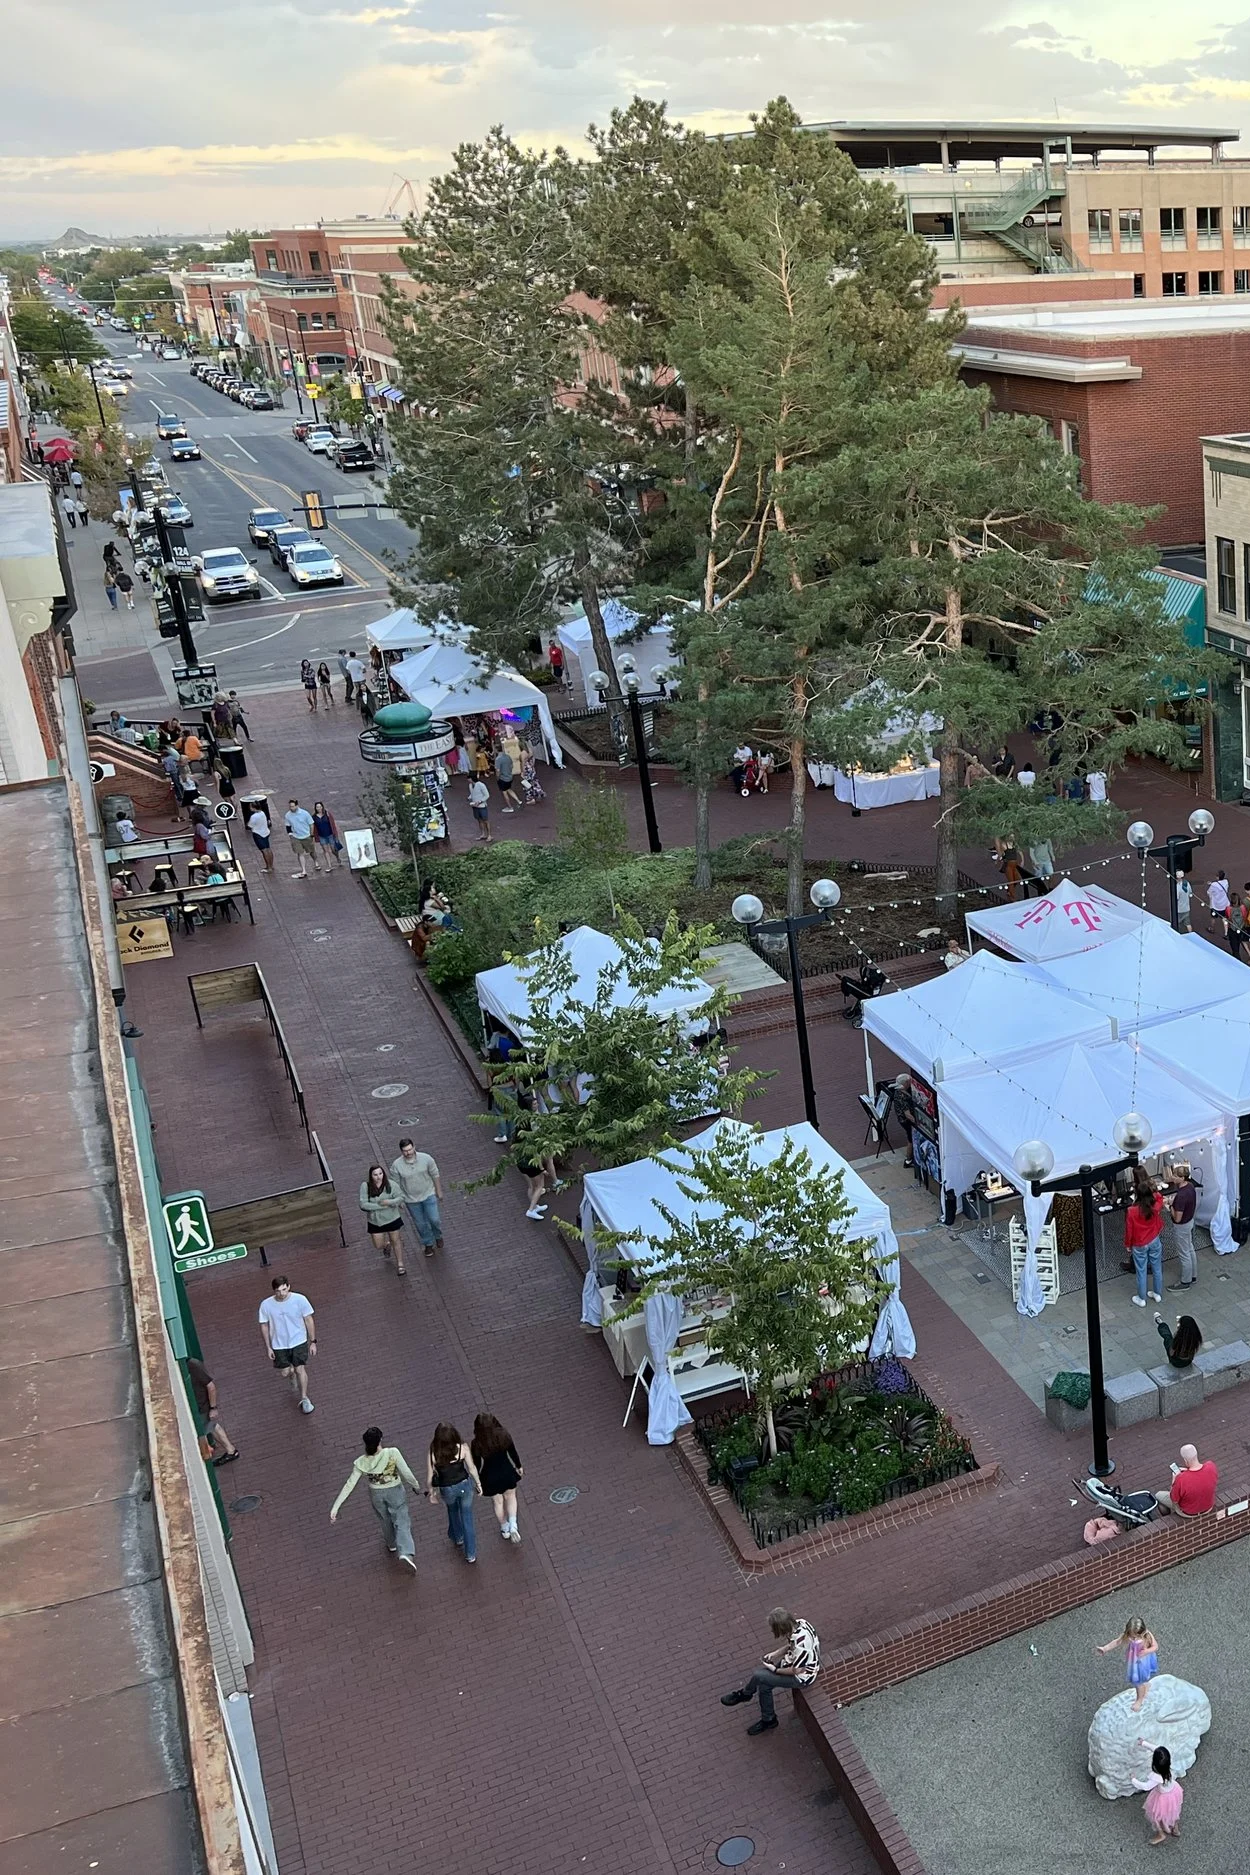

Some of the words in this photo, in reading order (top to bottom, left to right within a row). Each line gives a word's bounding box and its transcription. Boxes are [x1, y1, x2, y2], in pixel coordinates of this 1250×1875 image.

[172, 546, 189, 557] 124
[133, 941, 170, 952] Diamond
[185, 1251, 237, 1268] Shoes
